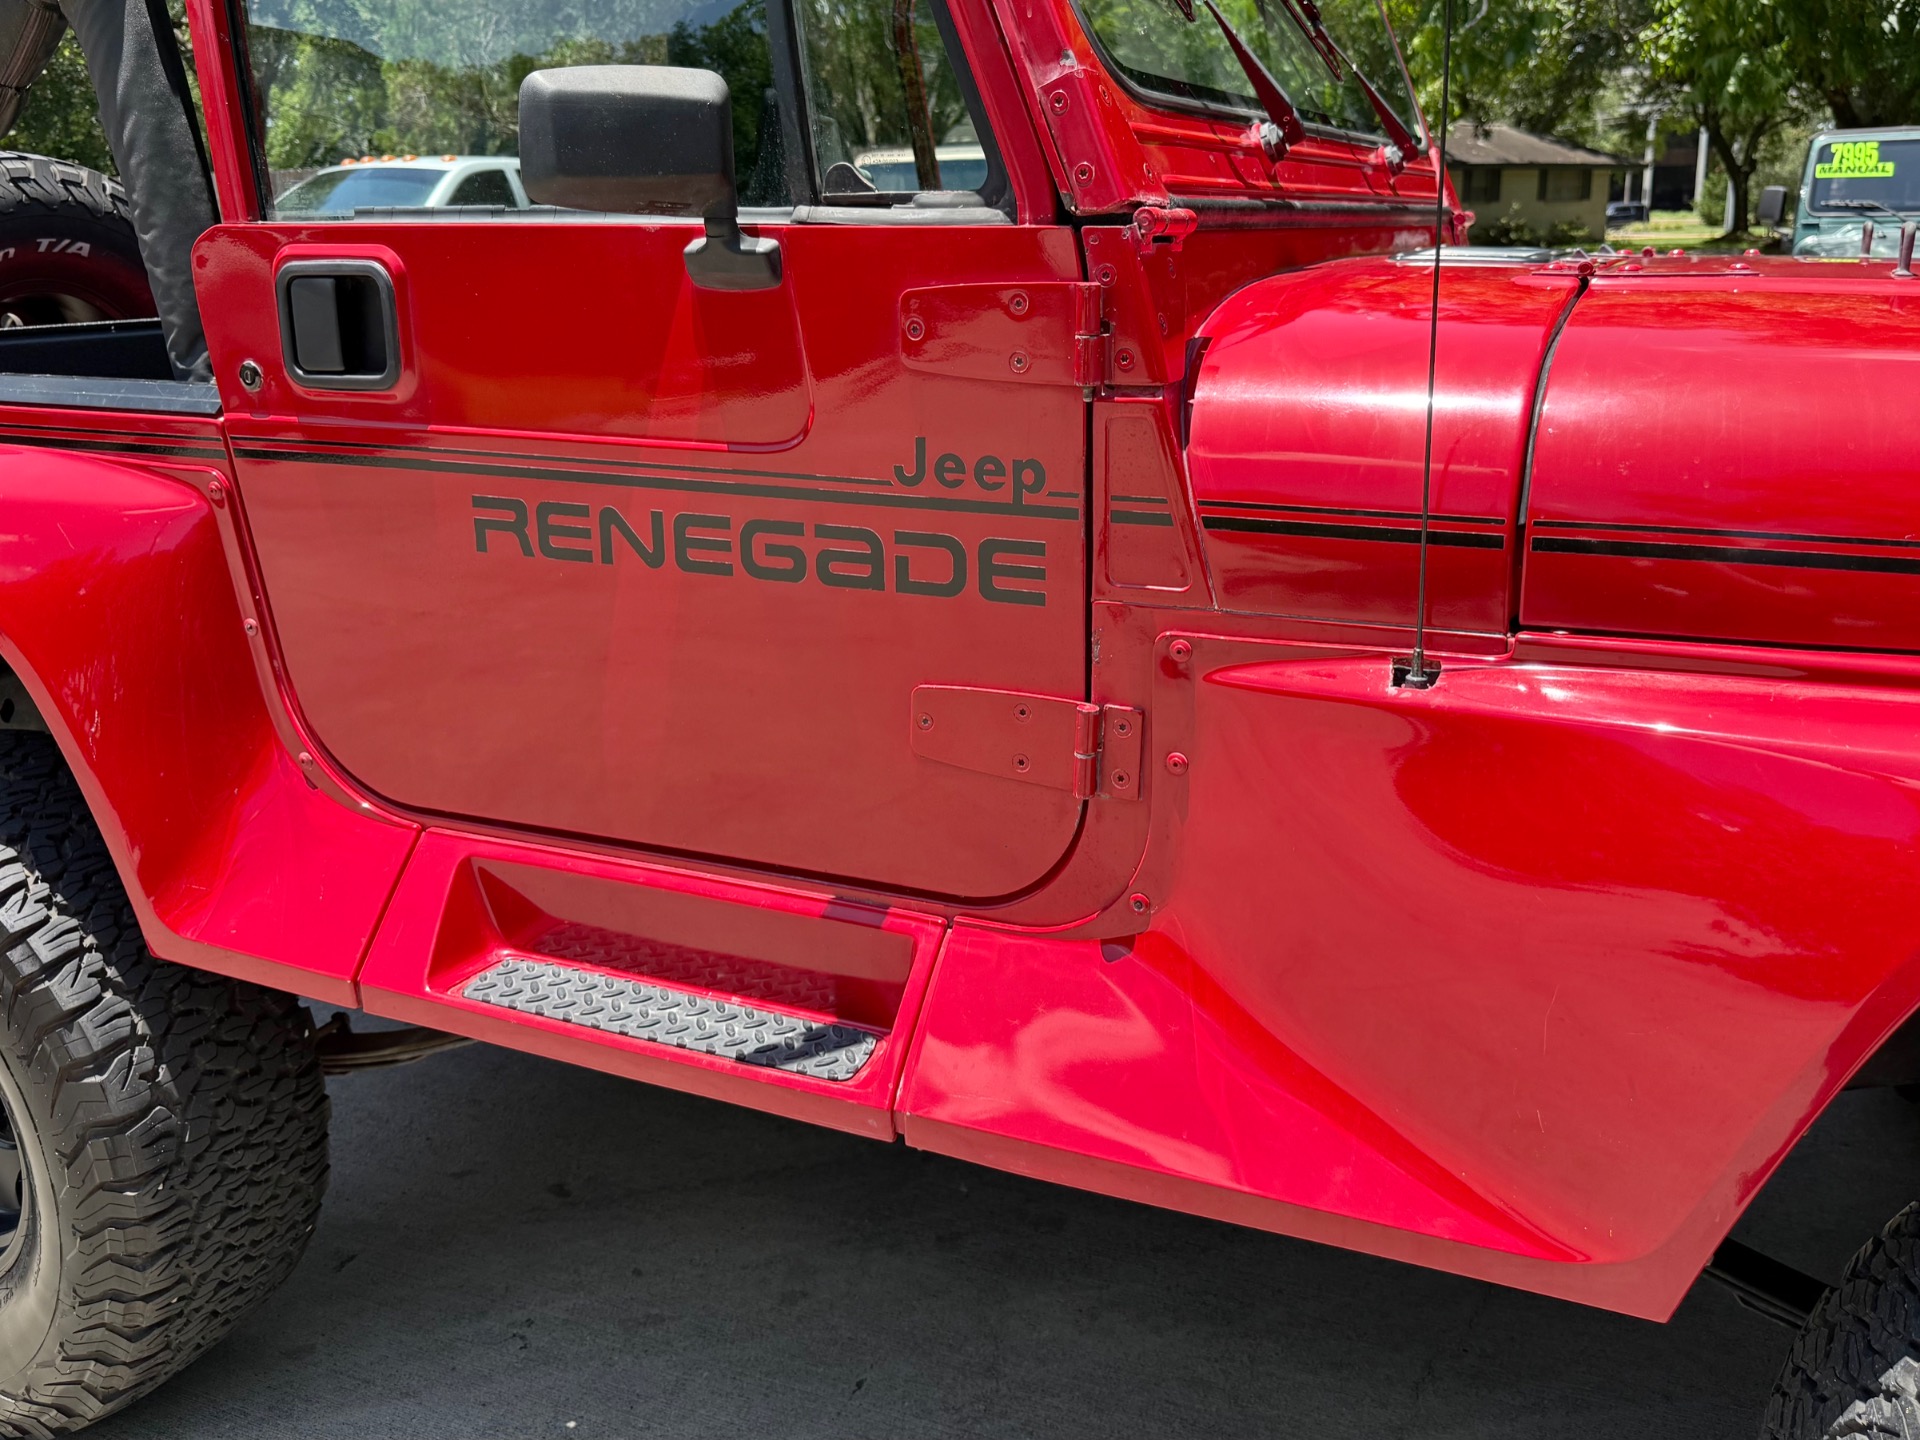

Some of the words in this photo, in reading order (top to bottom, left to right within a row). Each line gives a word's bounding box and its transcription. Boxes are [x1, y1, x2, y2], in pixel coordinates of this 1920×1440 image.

[1831, 141, 1879, 169] 7995
[1818, 164, 1892, 175] MANUAL
[36, 238, 90, 258] T/A
[893, 436, 1046, 505] Jeep
[471, 494, 1047, 606] RENEGADE
